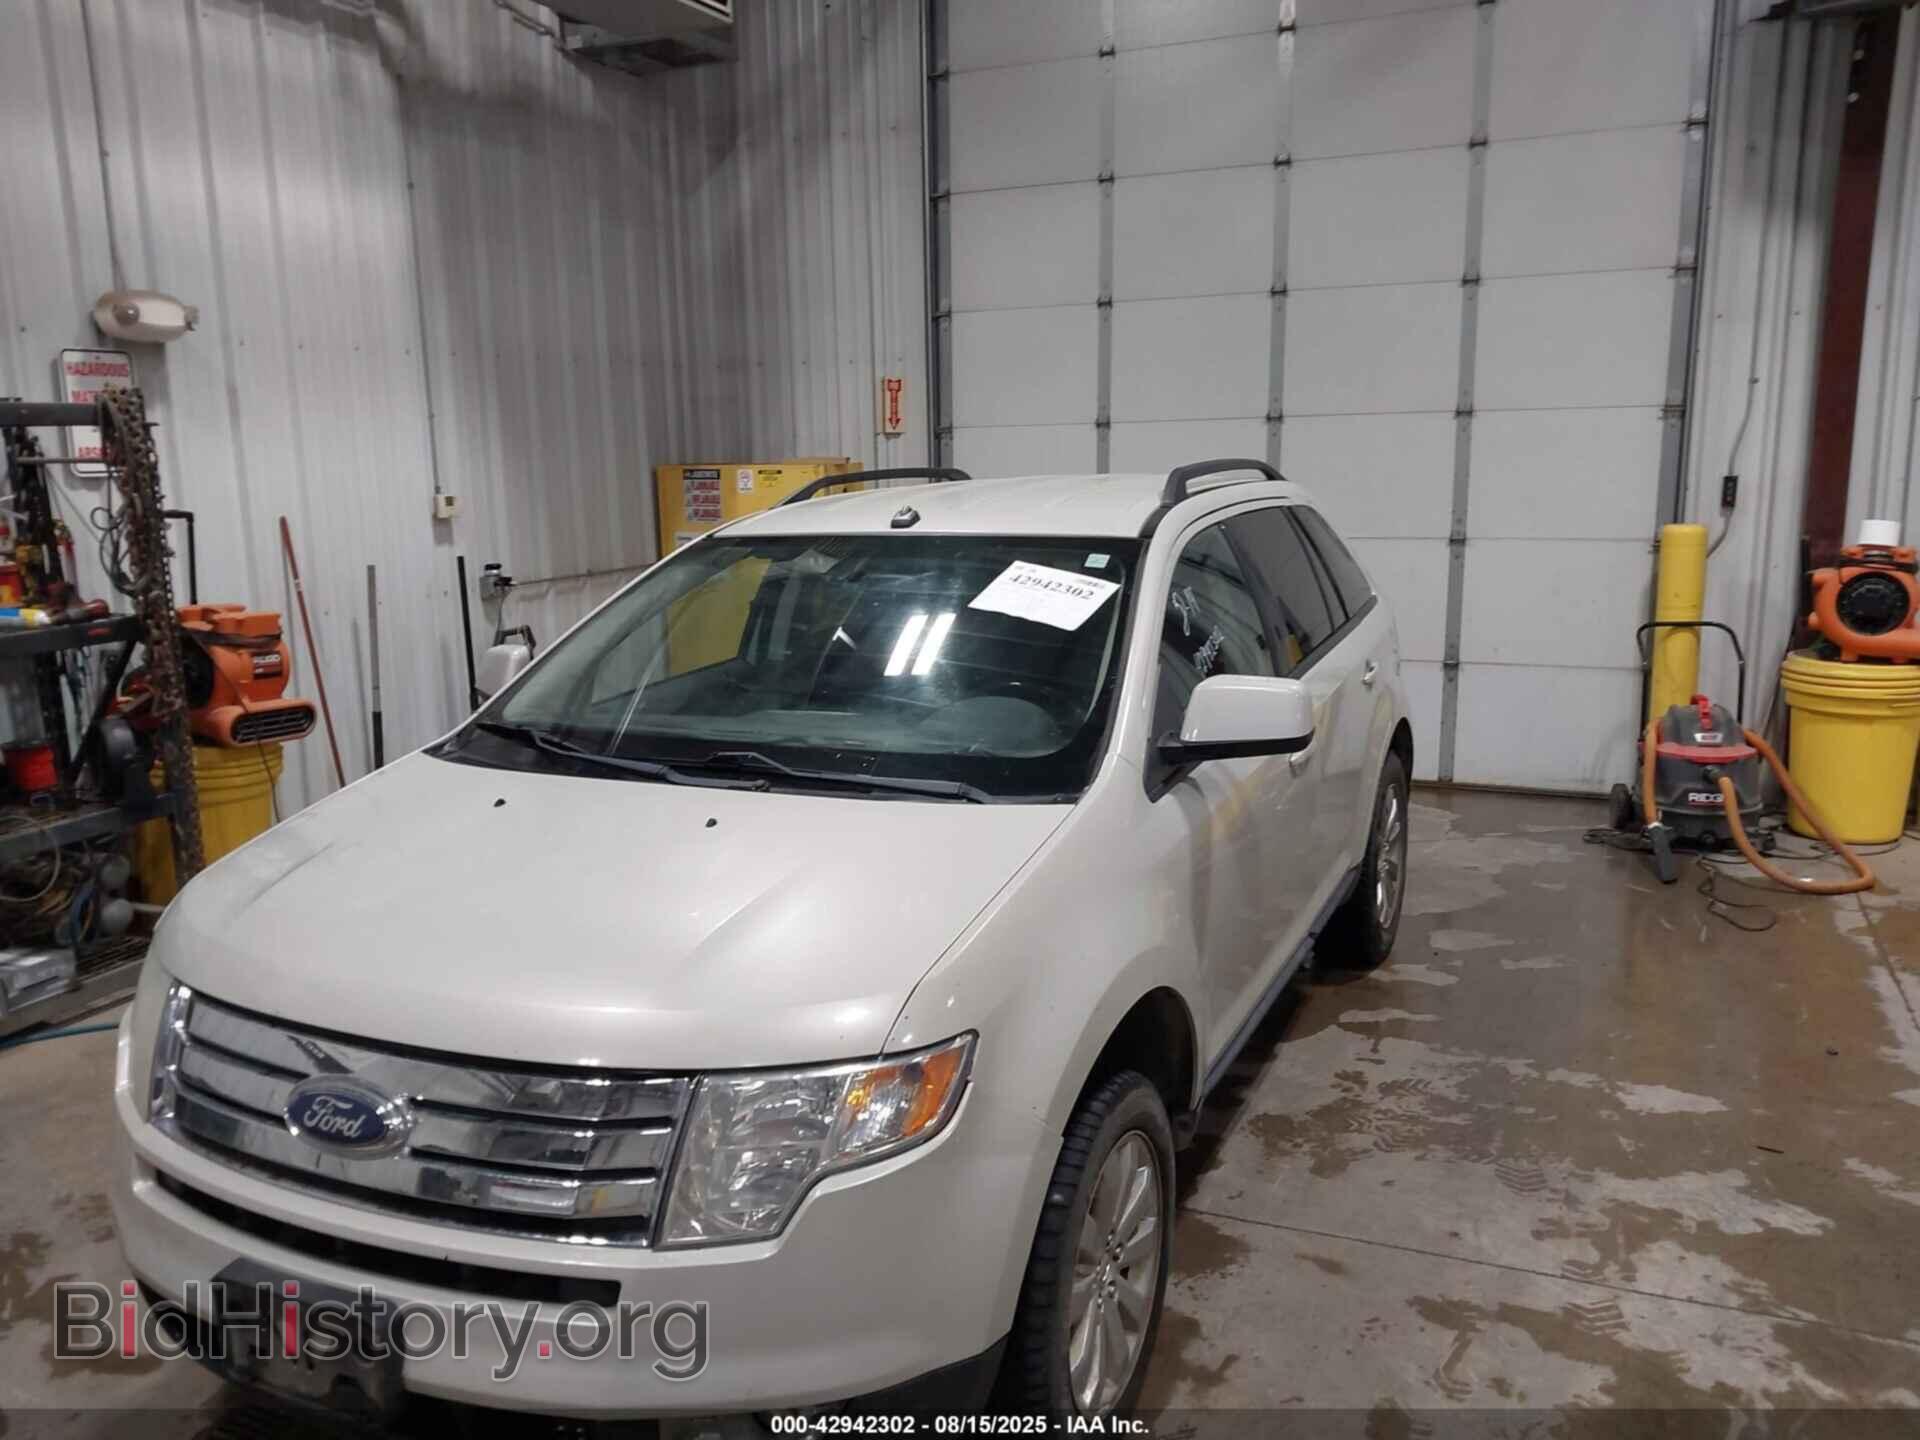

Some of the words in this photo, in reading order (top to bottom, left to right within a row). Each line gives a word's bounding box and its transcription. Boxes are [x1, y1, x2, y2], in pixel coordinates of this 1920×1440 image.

[65, 362, 129, 377] HAZARDOUS
[1688, 793, 1724, 803] RIDG
[303, 1095, 367, 1138] Ford
